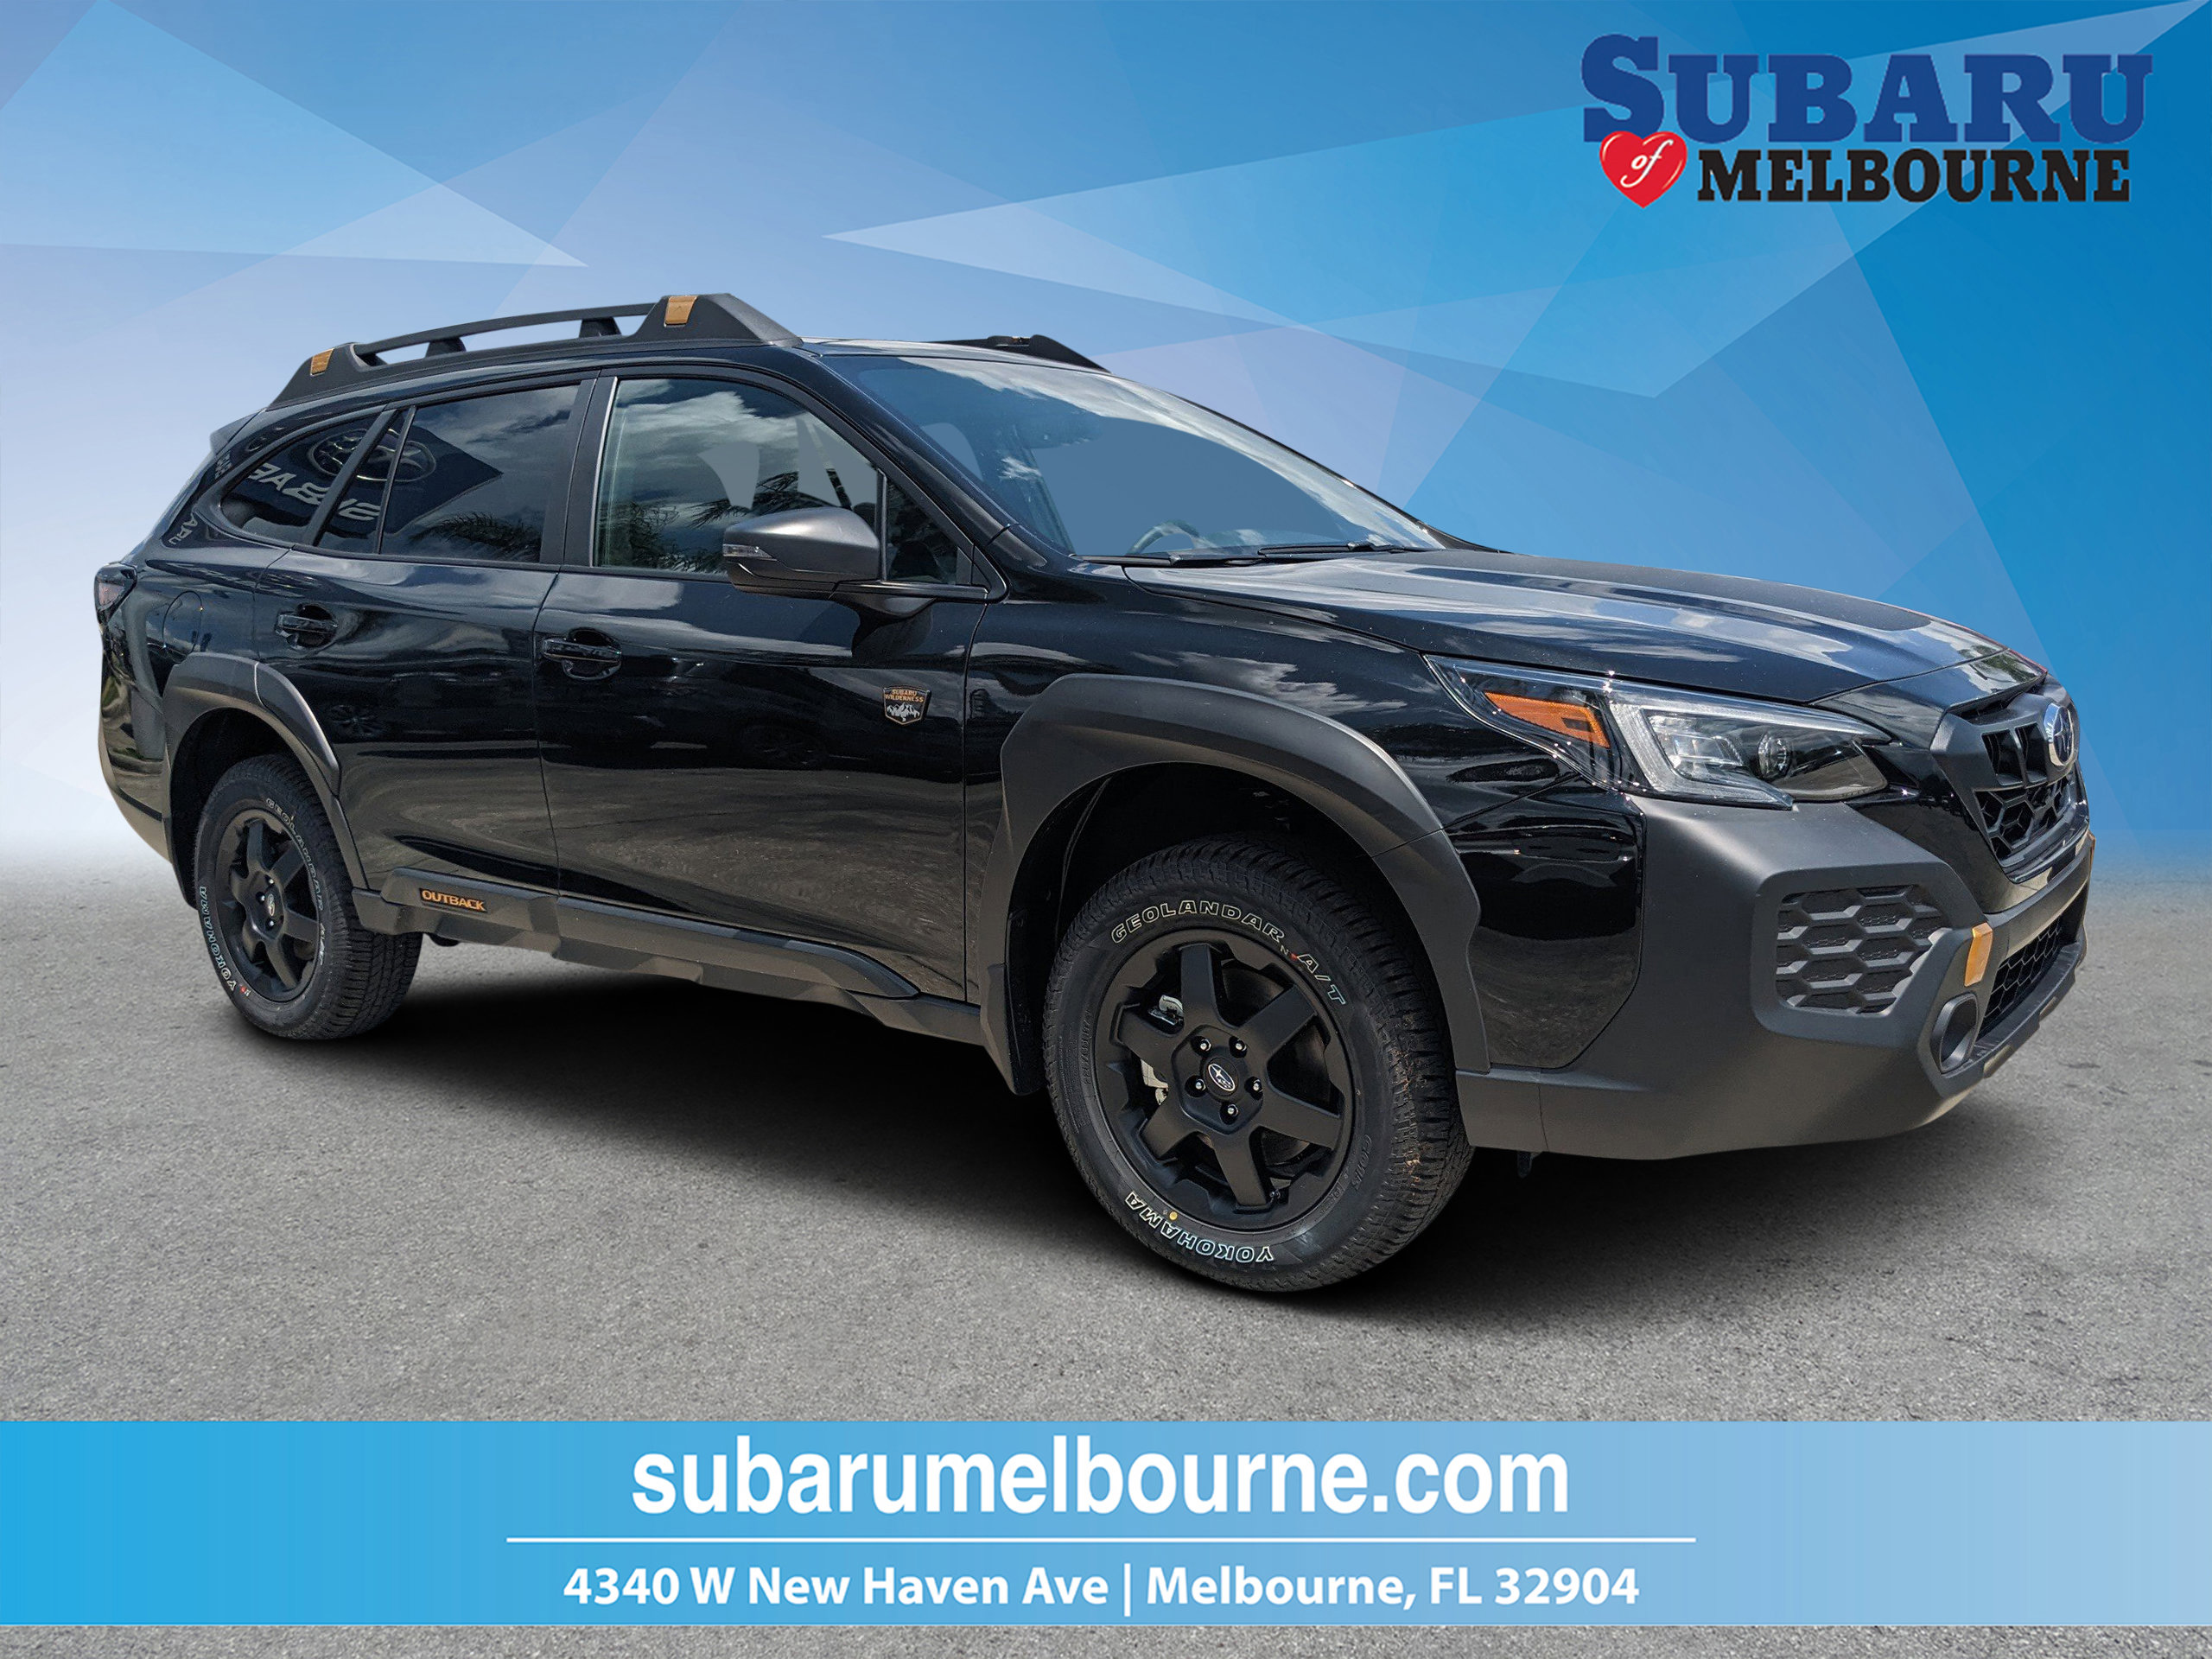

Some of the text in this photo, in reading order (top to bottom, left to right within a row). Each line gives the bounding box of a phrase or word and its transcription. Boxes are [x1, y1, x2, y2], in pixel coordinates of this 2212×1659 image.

[885, 694, 925, 702] WILDERNESS
[422, 890, 486, 912] OUTBACK
[199, 886, 238, 992] YOKOHAMA
[1111, 899, 1285, 944] GEOLANDAR
[1297, 953, 1346, 1005] A/T
[1125, 1191, 1274, 1263] YOKOHAMA
